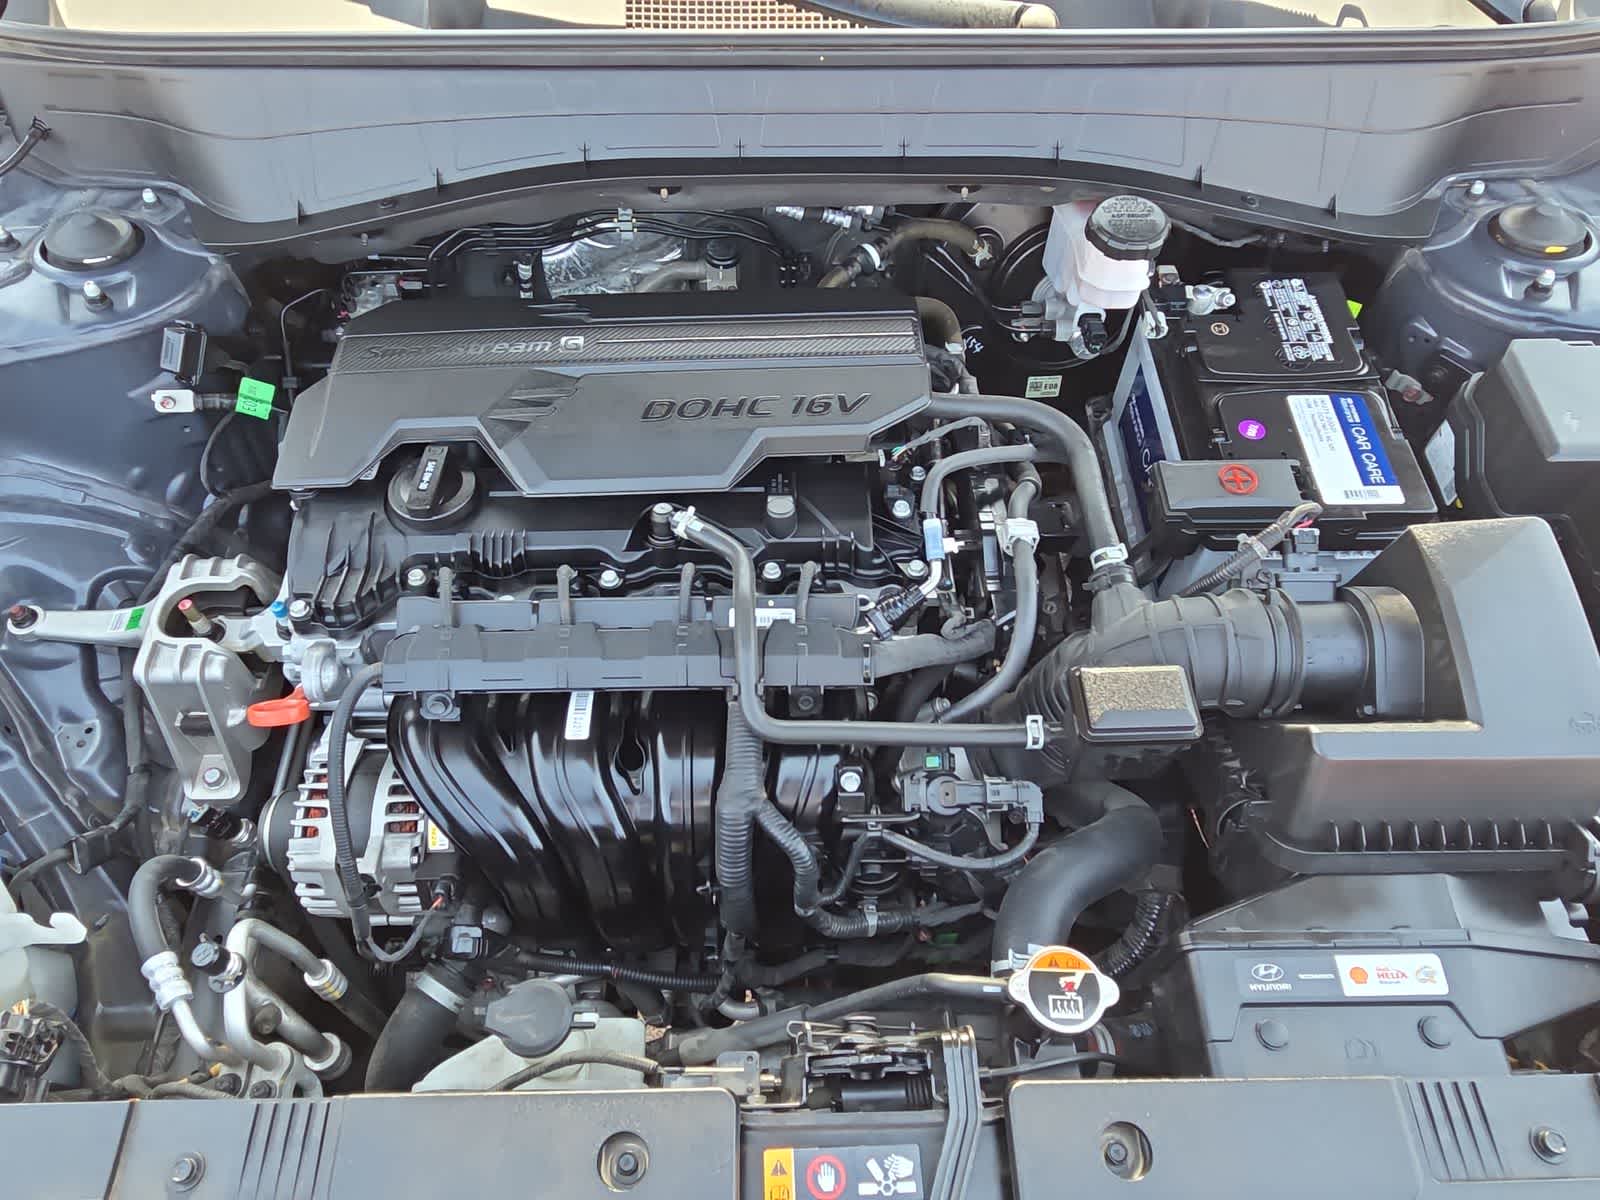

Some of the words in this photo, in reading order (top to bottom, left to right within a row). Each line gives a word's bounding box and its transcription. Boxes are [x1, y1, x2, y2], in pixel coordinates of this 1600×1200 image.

[640, 395, 780, 422] DOHC
[792, 392, 872, 417] 16V
[1351, 426, 1372, 451] CAR
[1361, 452, 1386, 485] CARE
[1248, 983, 1293, 992] HYUNDAI
